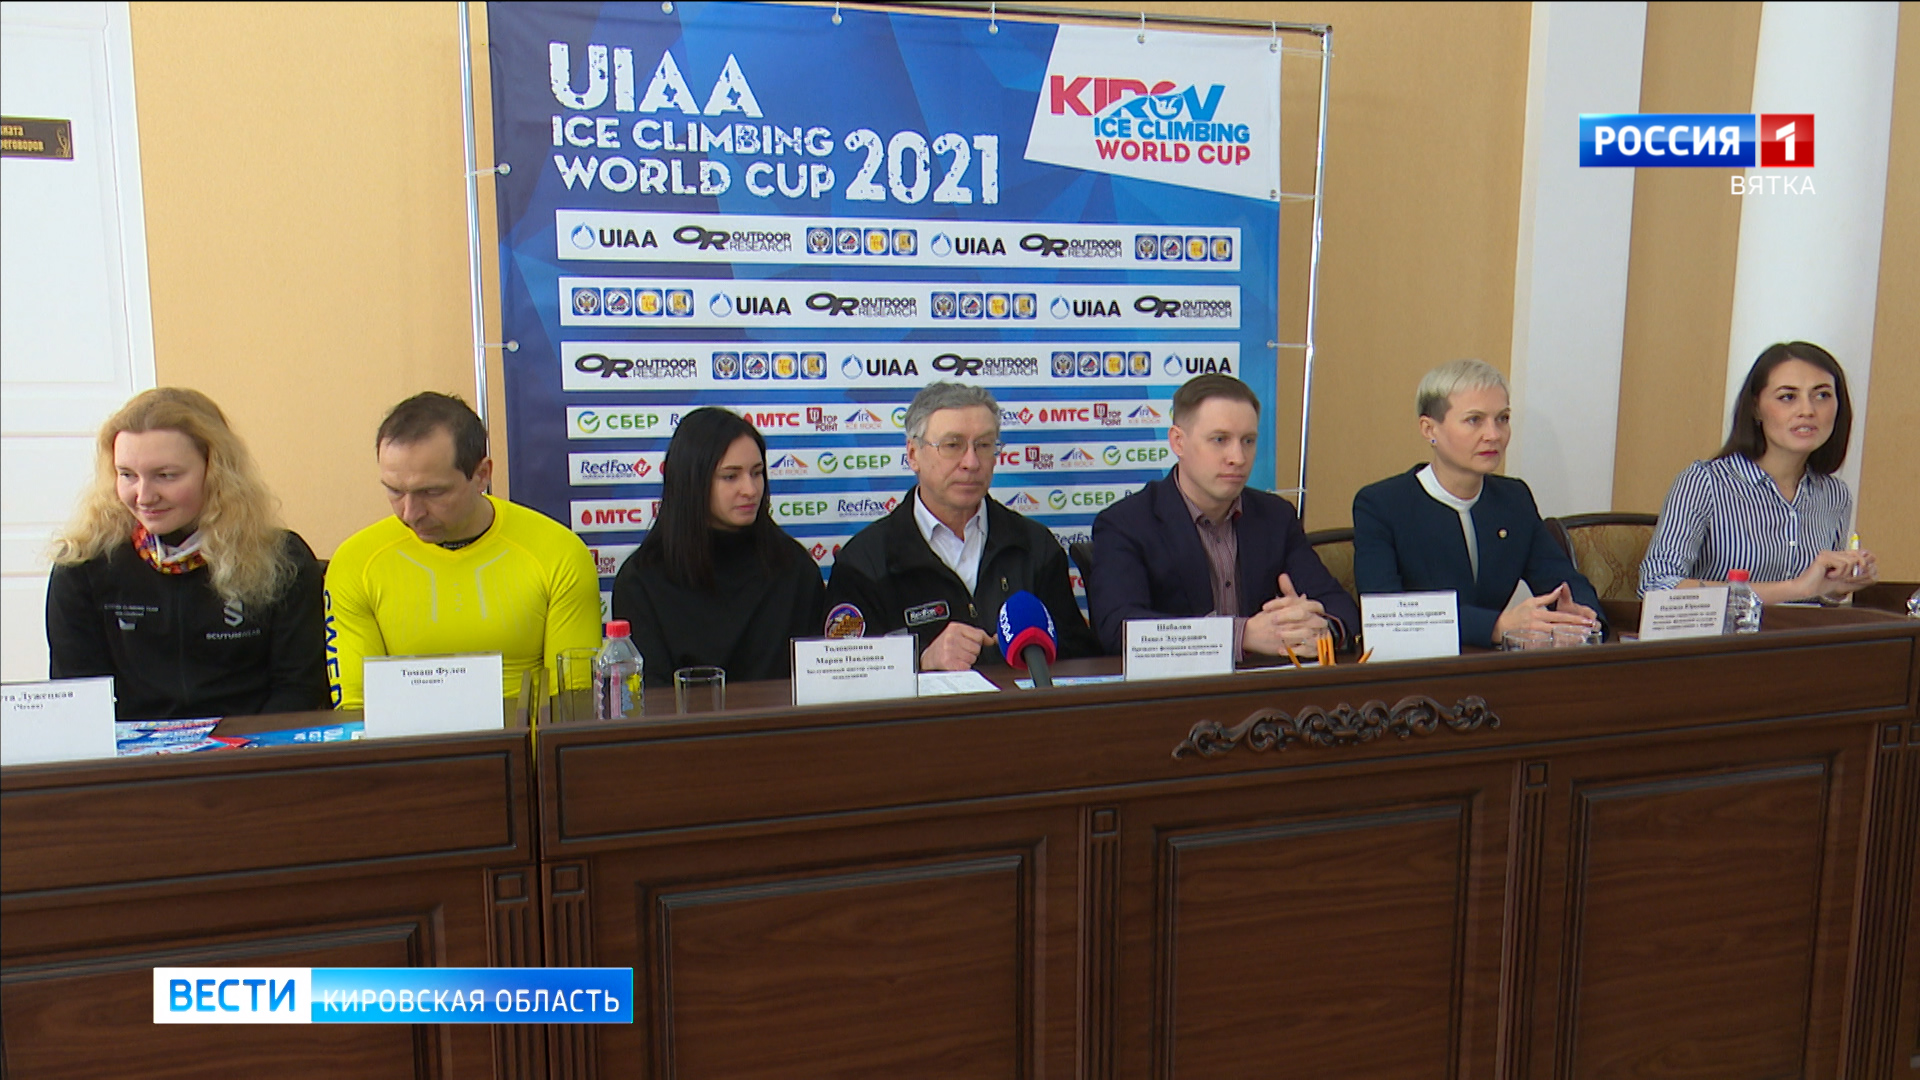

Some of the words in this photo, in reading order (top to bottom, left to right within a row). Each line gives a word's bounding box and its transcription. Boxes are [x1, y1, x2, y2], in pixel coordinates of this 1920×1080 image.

[548, 42, 764, 117] UIAA
[1050, 75, 1226, 122] KIROV
[552, 115, 620, 148] ICE
[632, 118, 834, 157] CLIMBING
[1094, 117, 1131, 138] ICE
[1137, 119, 1250, 144] CLIMBING
[1095, 139, 1190, 163] WORLD
[1198, 144, 1251, 166] CUP
[844, 129, 999, 205] 2021
[553, 154, 732, 196] WORLD
[744, 160, 837, 199] CUP
[599, 229, 658, 248] UIAA
[732, 231, 792, 242] OUTDOOR
[955, 237, 1006, 256] UIAA
[1070, 239, 1122, 250] OUTDOOR
[736, 296, 792, 315] UIAA
[861, 297, 917, 308] OUTDOOR
[1073, 299, 1121, 317] UIAA
[1182, 300, 1231, 310] OUTDOOR
[635, 359, 696, 368] OUTDOOR
[866, 358, 919, 377] UIAA
[985, 357, 1037, 367] OUTDOOR
[1185, 357, 1231, 374] UIAA
[756, 413, 800, 428] МТС
[823, 415, 838, 423] TOP
[1000, 408, 1018, 419] Fox
[1051, 408, 1090, 422] МТС
[606, 414, 659, 429] СБЕР
[815, 423, 838, 432] POINT
[1101, 418, 1121, 426] POINT
[996, 451, 1020, 466] ТС
[1040, 453, 1054, 462] TOP
[1126, 447, 1169, 462] СБЕР
[581, 459, 634, 475] RedFox
[843, 455, 891, 470] СБЕР
[1033, 461, 1054, 470] POINT
[837, 499, 885, 513] RedFox
[1072, 491, 1116, 506] СБЕР
[595, 508, 642, 524] МТС
[779, 501, 828, 516] СБЕР
[1054, 533, 1092, 545] RedFo
[597, 565, 615, 574] OINT
[401, 668, 433, 678] Томаш
